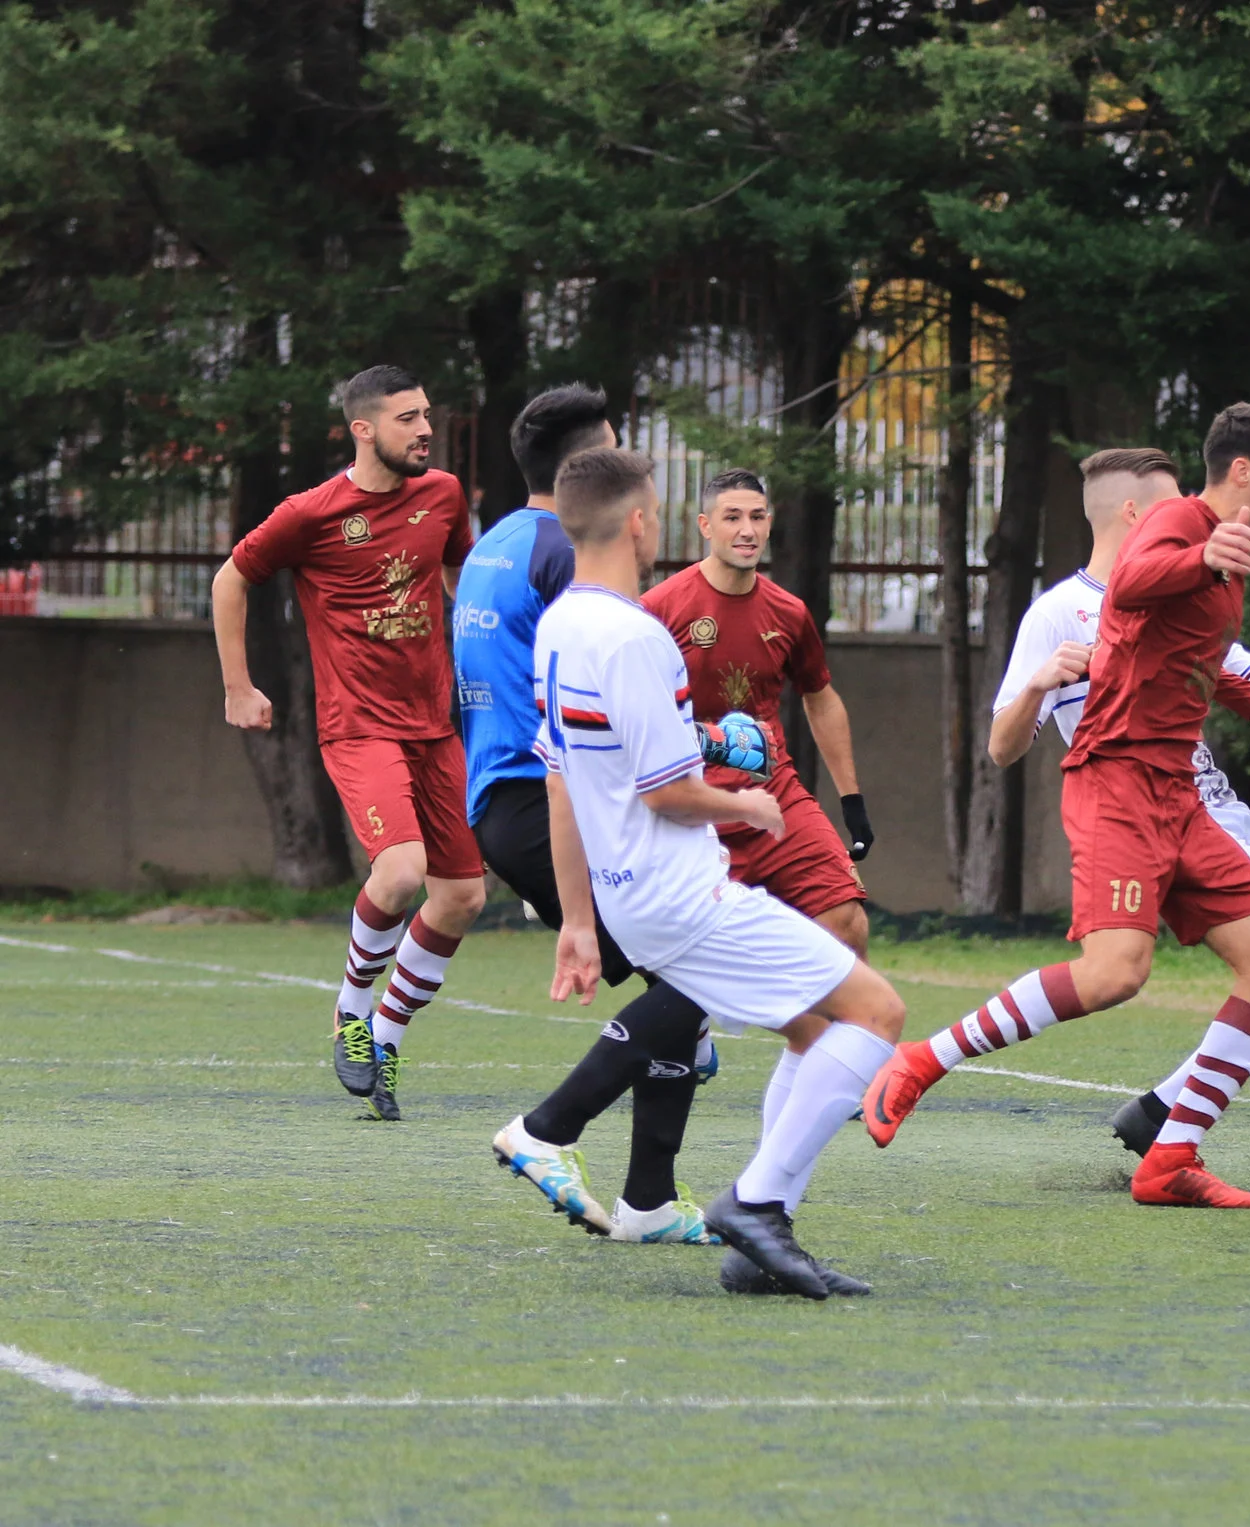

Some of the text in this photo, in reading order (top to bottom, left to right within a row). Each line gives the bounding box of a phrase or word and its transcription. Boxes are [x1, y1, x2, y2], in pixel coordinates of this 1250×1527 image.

[367, 806, 384, 836] 5
[602, 868, 634, 888] Spa
[1110, 880, 1142, 912] 10
